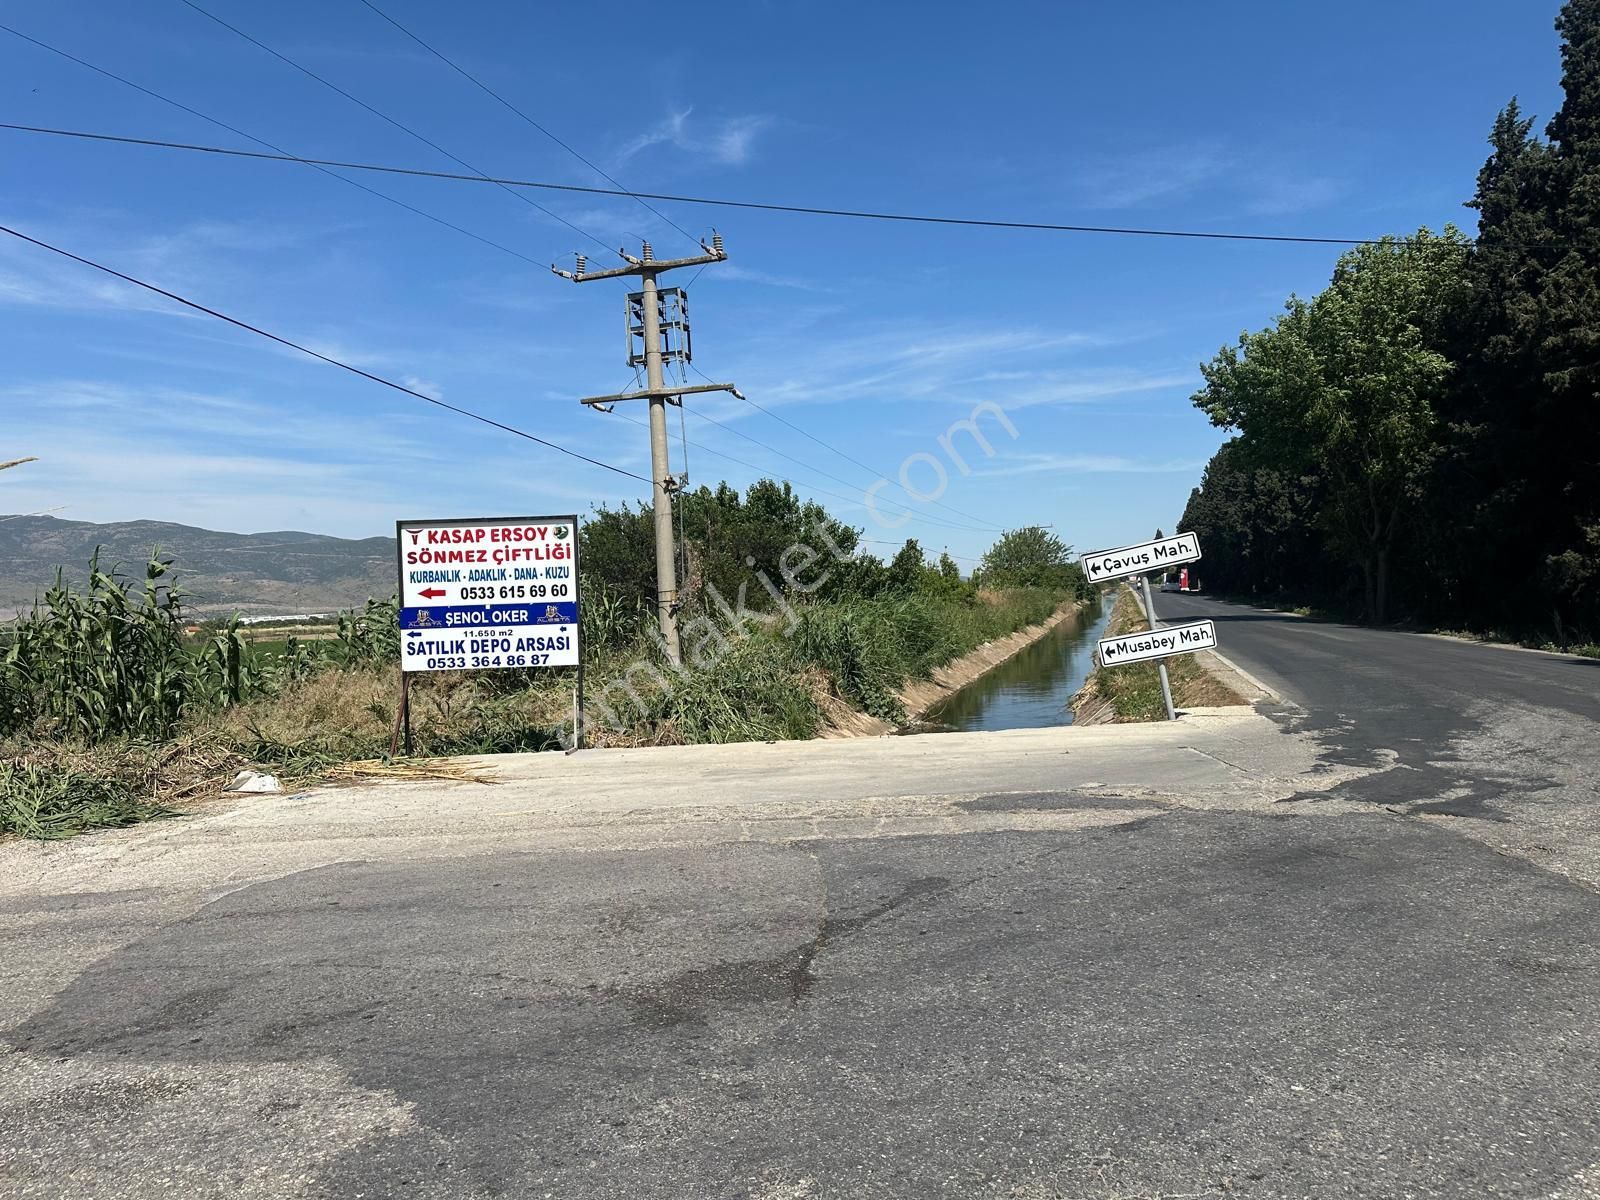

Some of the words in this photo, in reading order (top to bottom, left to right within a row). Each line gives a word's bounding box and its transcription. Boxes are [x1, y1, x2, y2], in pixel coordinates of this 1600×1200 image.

[427, 529, 486, 544] KASAP
[490, 526, 548, 543] ERSOY
[407, 547, 487, 565] SÖNMEZ
[492, 542, 571, 565] ÇİFTLİĞİ
[1103, 552, 1150, 573] Çavuş
[1153, 541, 1192, 560] Mah.
[410, 570, 461, 583] KURBANLIK
[468, 568, 507, 582] ADAKLIK
[514, 567, 538, 580] DANA
[545, 566, 569, 579] KUZU
[460, 586, 495, 600] 0533
[499, 585, 525, 599] 615
[529, 584, 546, 598] 69
[550, 583, 568, 597] 60
[445, 611, 489, 627] ŞENOL
[491, 609, 529, 623] OKER
[463, 629, 496, 637] 11.650
[1116, 633, 1176, 655] Musabey
[1179, 627, 1212, 644] Mah.
[406, 640, 466, 656] SATILIK
[470, 638, 511, 654] DEPO
[515, 636, 570, 652] ARSASI
[427, 656, 466, 669] 0533
[471, 655, 502, 667] 364
[506, 654, 526, 666] 86
[530, 653, 550, 665] 87
